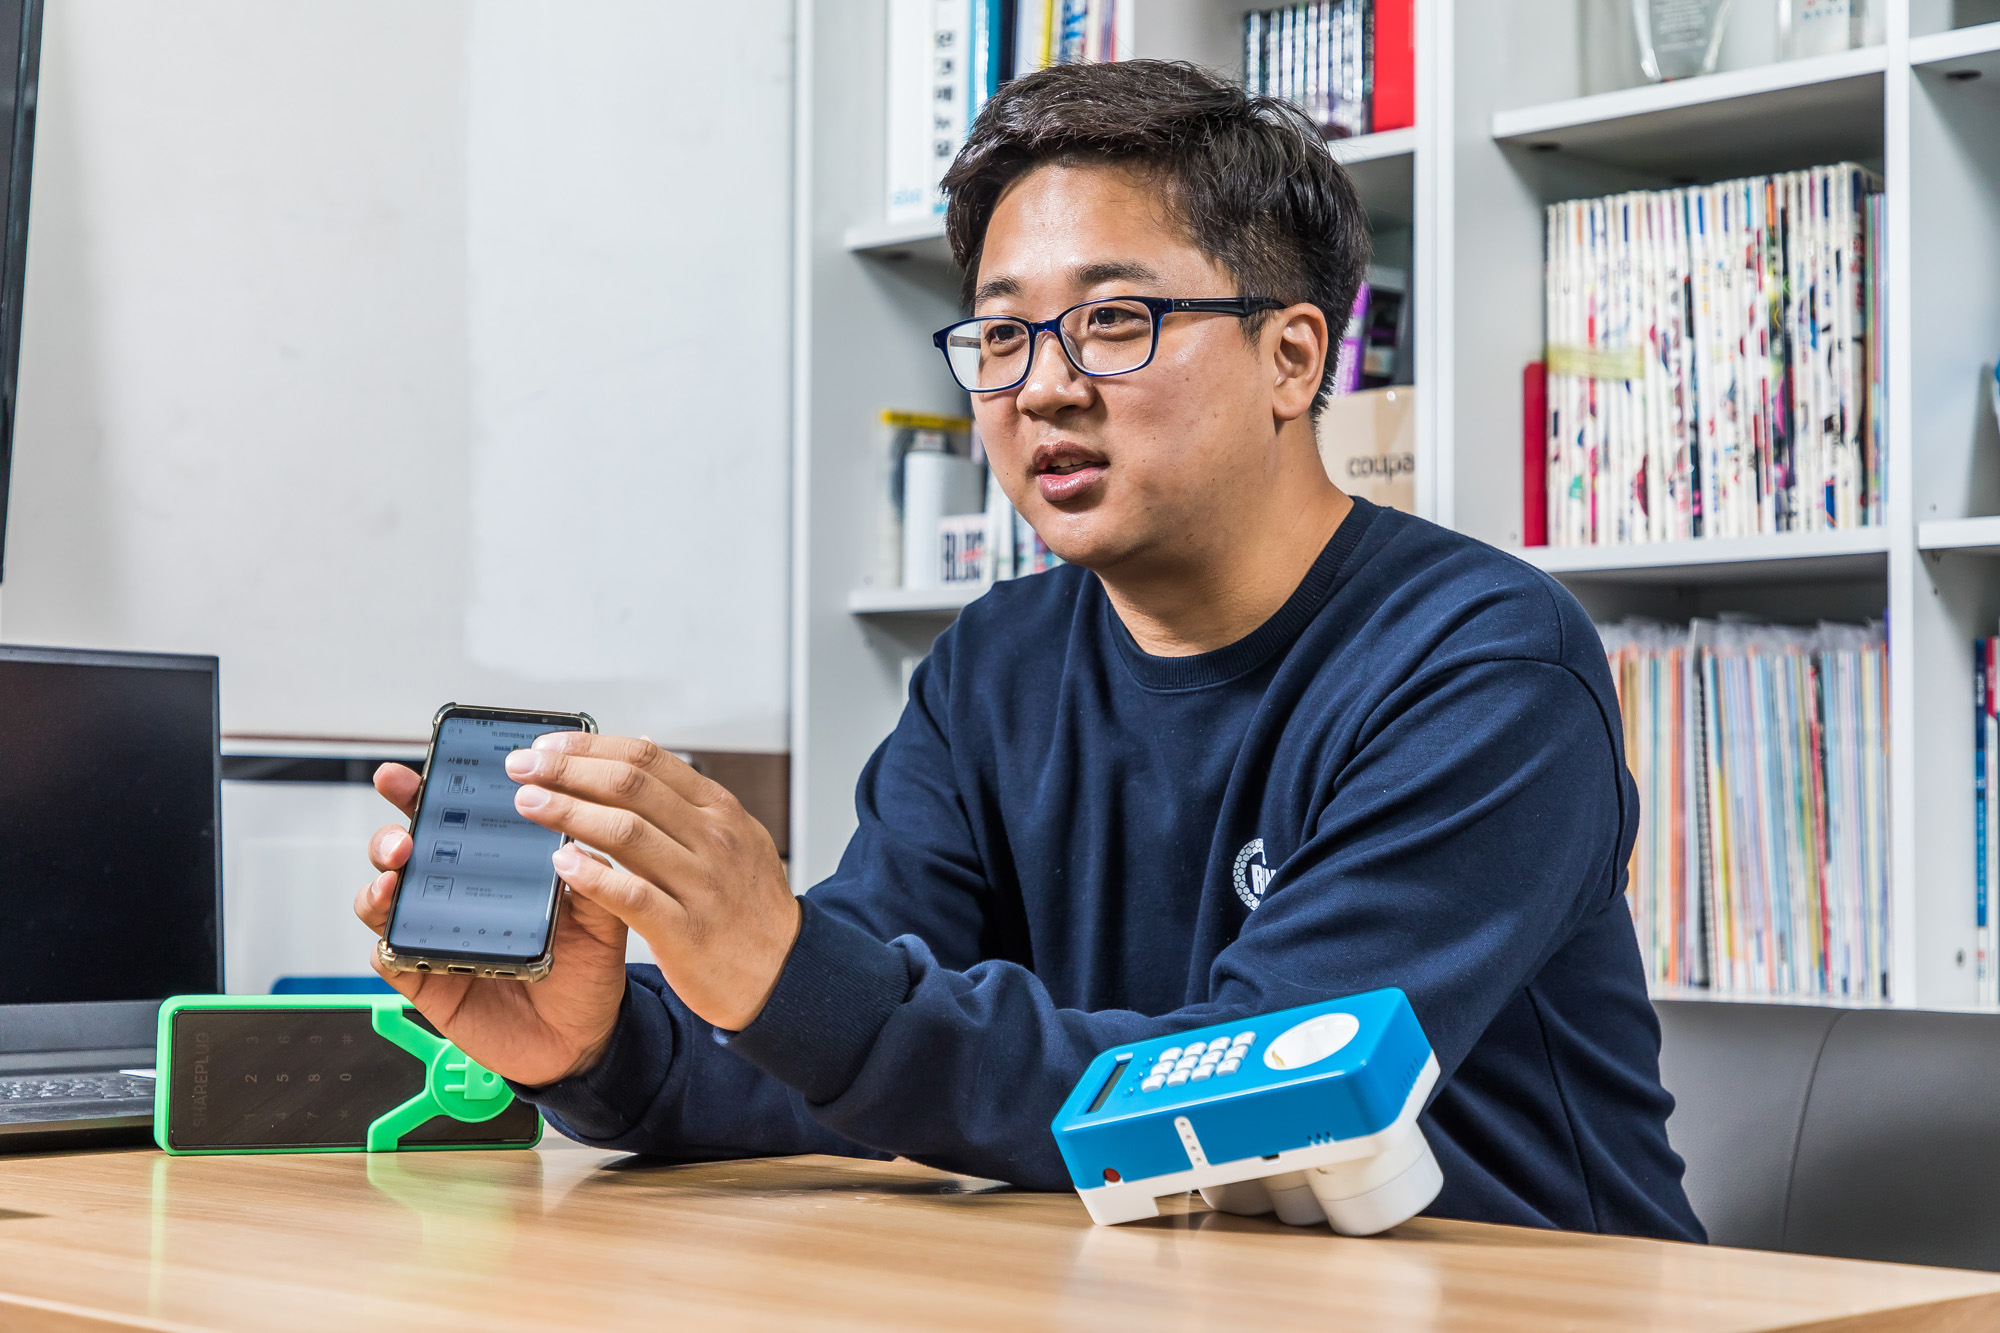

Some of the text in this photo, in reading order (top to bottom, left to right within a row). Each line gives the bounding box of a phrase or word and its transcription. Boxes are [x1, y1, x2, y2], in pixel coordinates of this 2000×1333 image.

[1347, 452, 1414, 483] coupa
[447, 756, 479, 766] 사용방법
[192, 1032, 210, 1128] SHAREPLUG
[245, 1074, 258, 1083] 2
[277, 1073, 289, 1082] 5
[308, 1073, 321, 1082] 8
